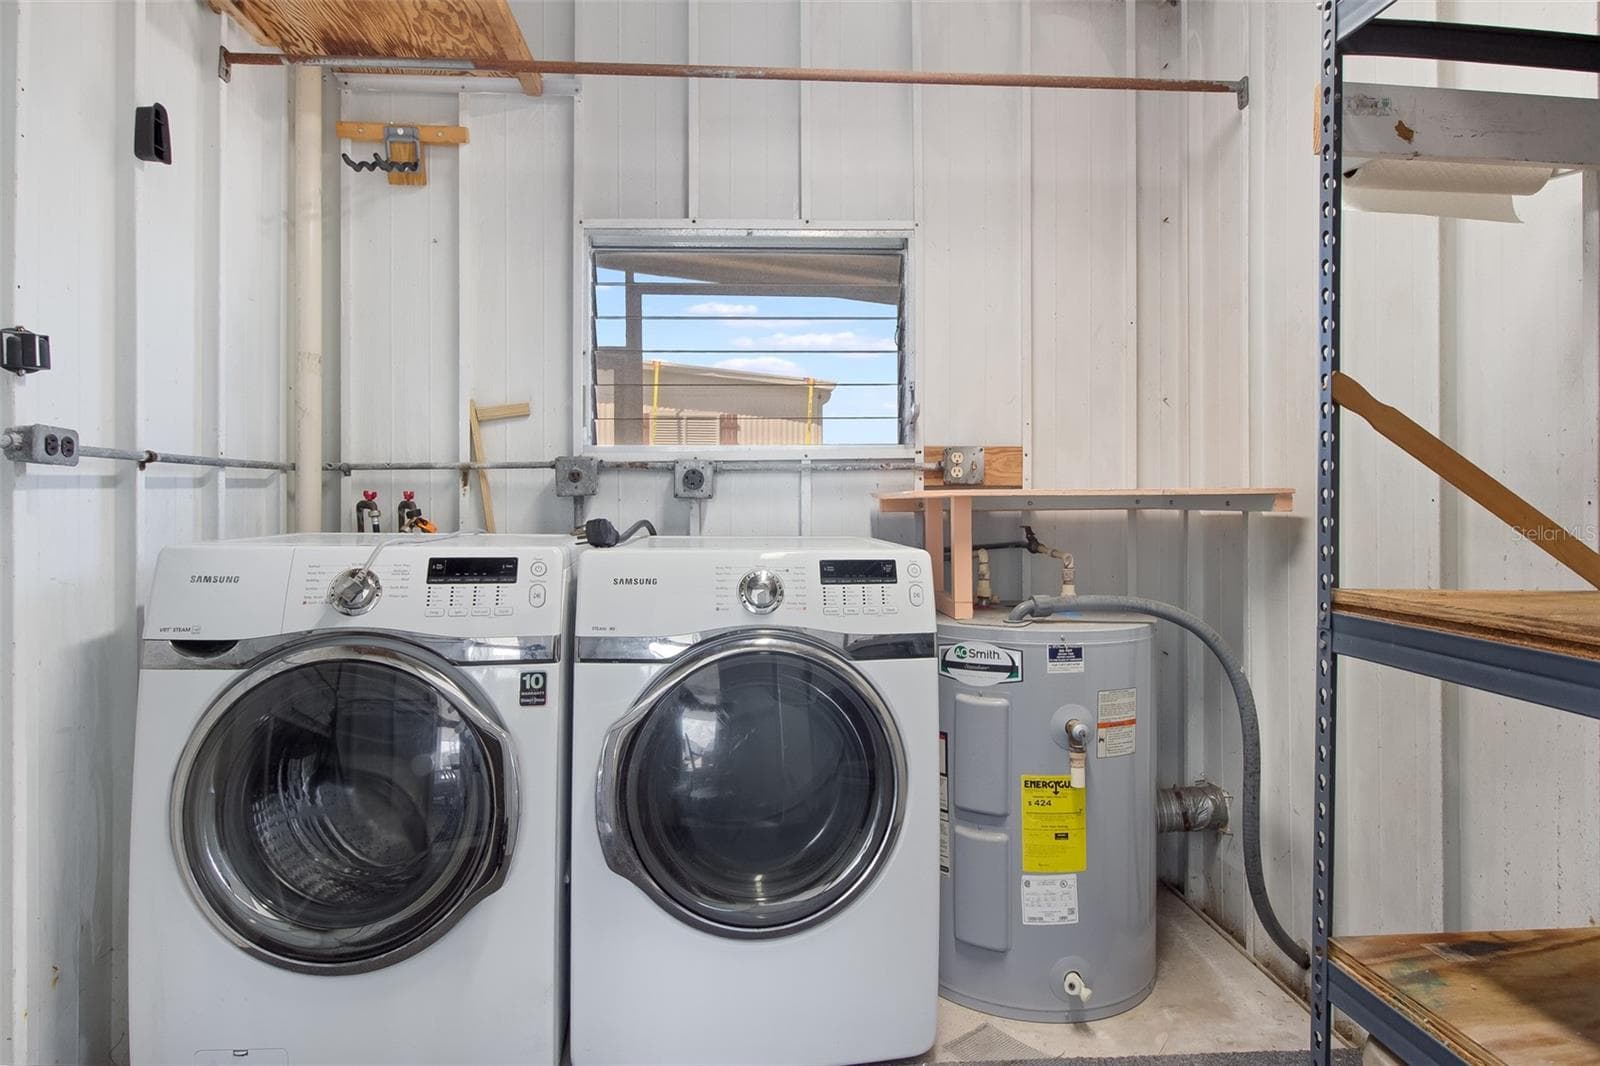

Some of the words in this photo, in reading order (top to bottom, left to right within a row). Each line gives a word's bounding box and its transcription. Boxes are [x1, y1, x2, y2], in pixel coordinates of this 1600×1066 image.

[189, 575, 240, 584] SAMSUNG
[612, 577, 658, 586] SAMSUNG
[968, 648, 1000, 660] Smith
[522, 673, 544, 689] 10
[1023, 780, 1073, 793] ENERGYGU
[1034, 799, 1052, 807] 424
